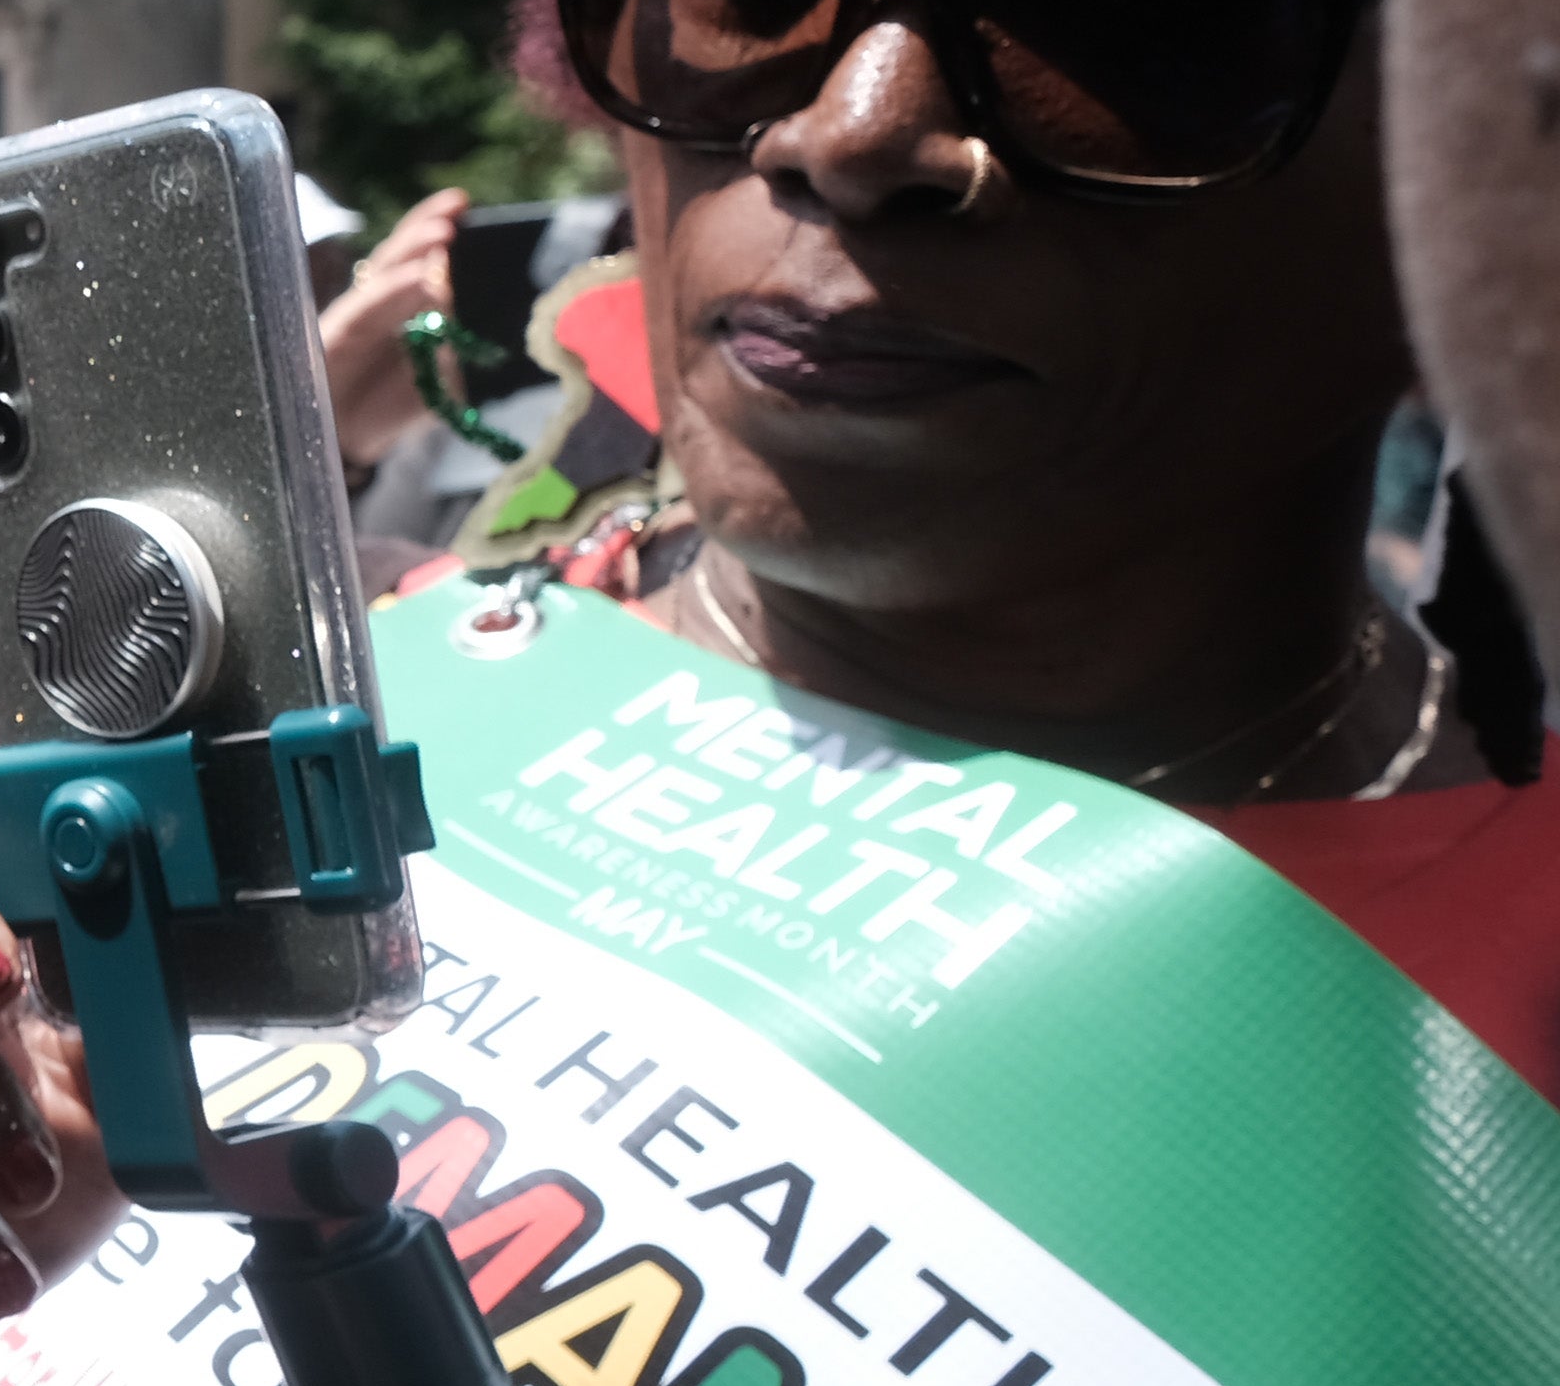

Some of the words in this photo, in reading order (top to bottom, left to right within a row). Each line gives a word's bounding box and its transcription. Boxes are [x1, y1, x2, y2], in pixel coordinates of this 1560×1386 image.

[517, 727, 1032, 990] HEALTH
[614, 670, 1078, 893] MENTAL
[423, 940, 541, 1059] TAL
[479, 789, 739, 916] AWARENESS
[738, 903, 942, 1029] MONTH
[569, 886, 709, 957] MAY
